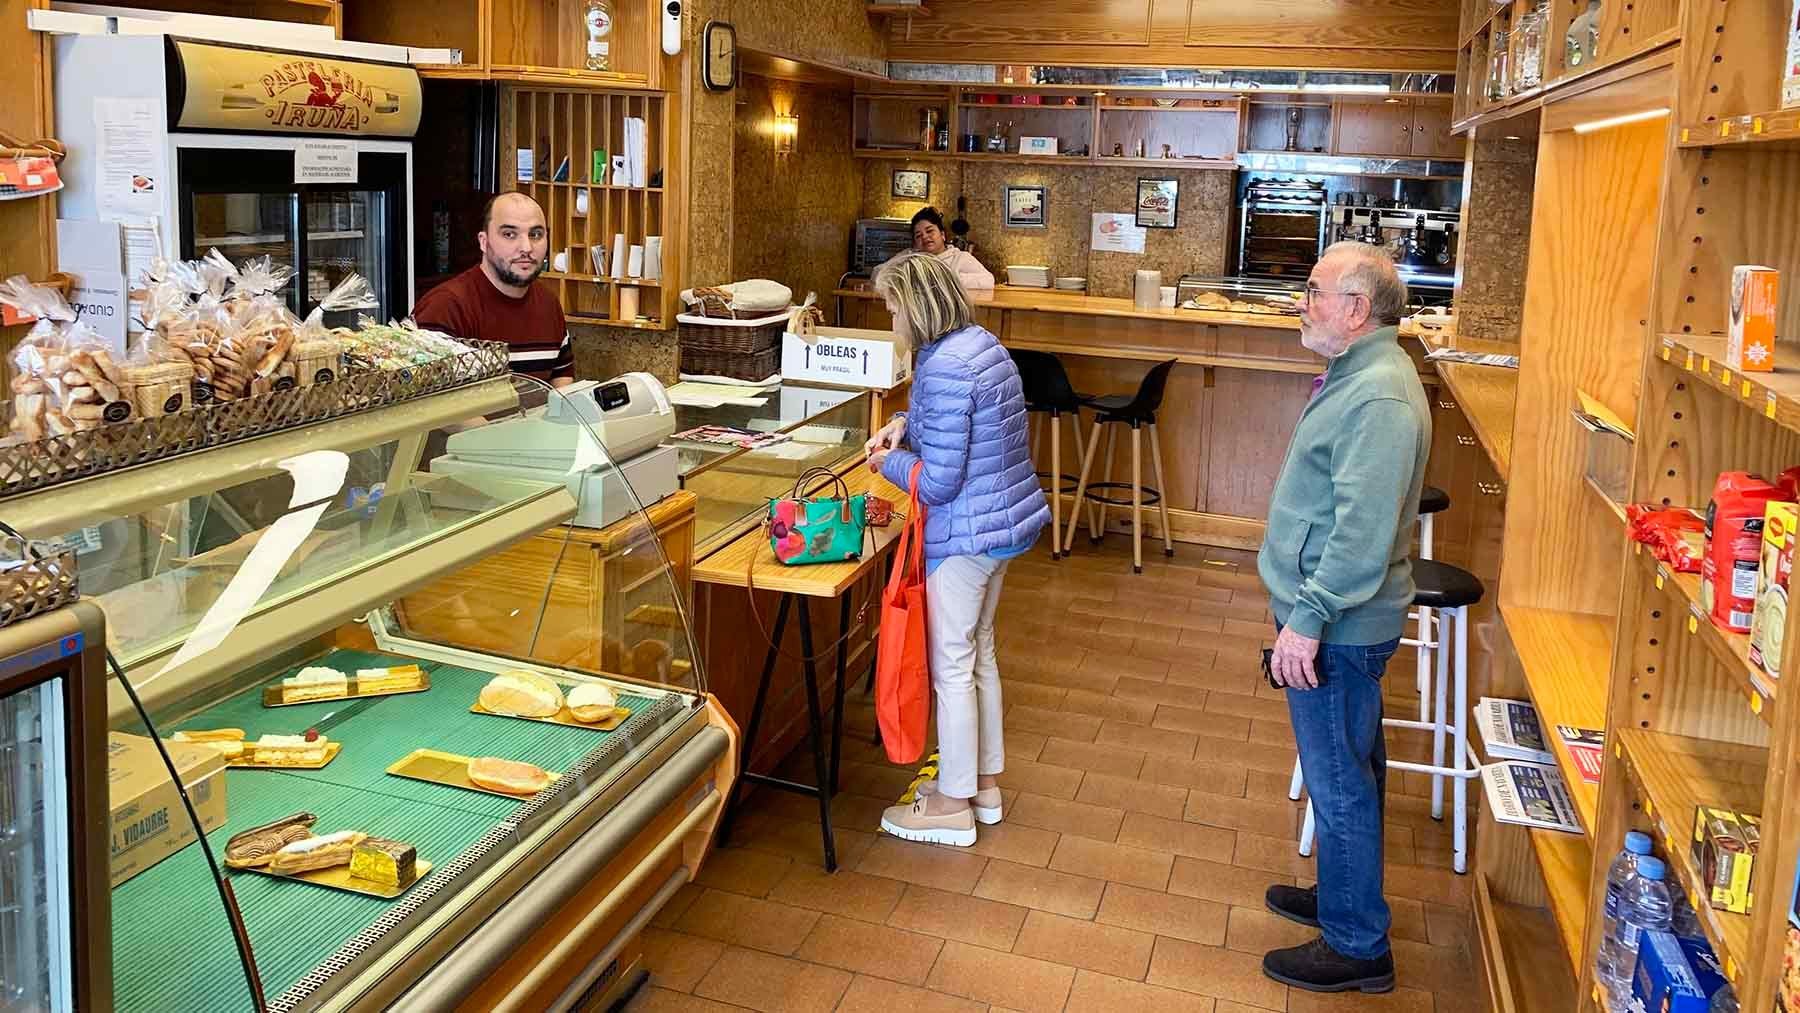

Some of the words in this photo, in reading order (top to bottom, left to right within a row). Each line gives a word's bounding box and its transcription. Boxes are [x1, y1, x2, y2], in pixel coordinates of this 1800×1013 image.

[271, 100, 361, 130] IRUÑA
[816, 343, 857, 358] OBLEAS
[123, 807, 169, 846] VIDAURRE
